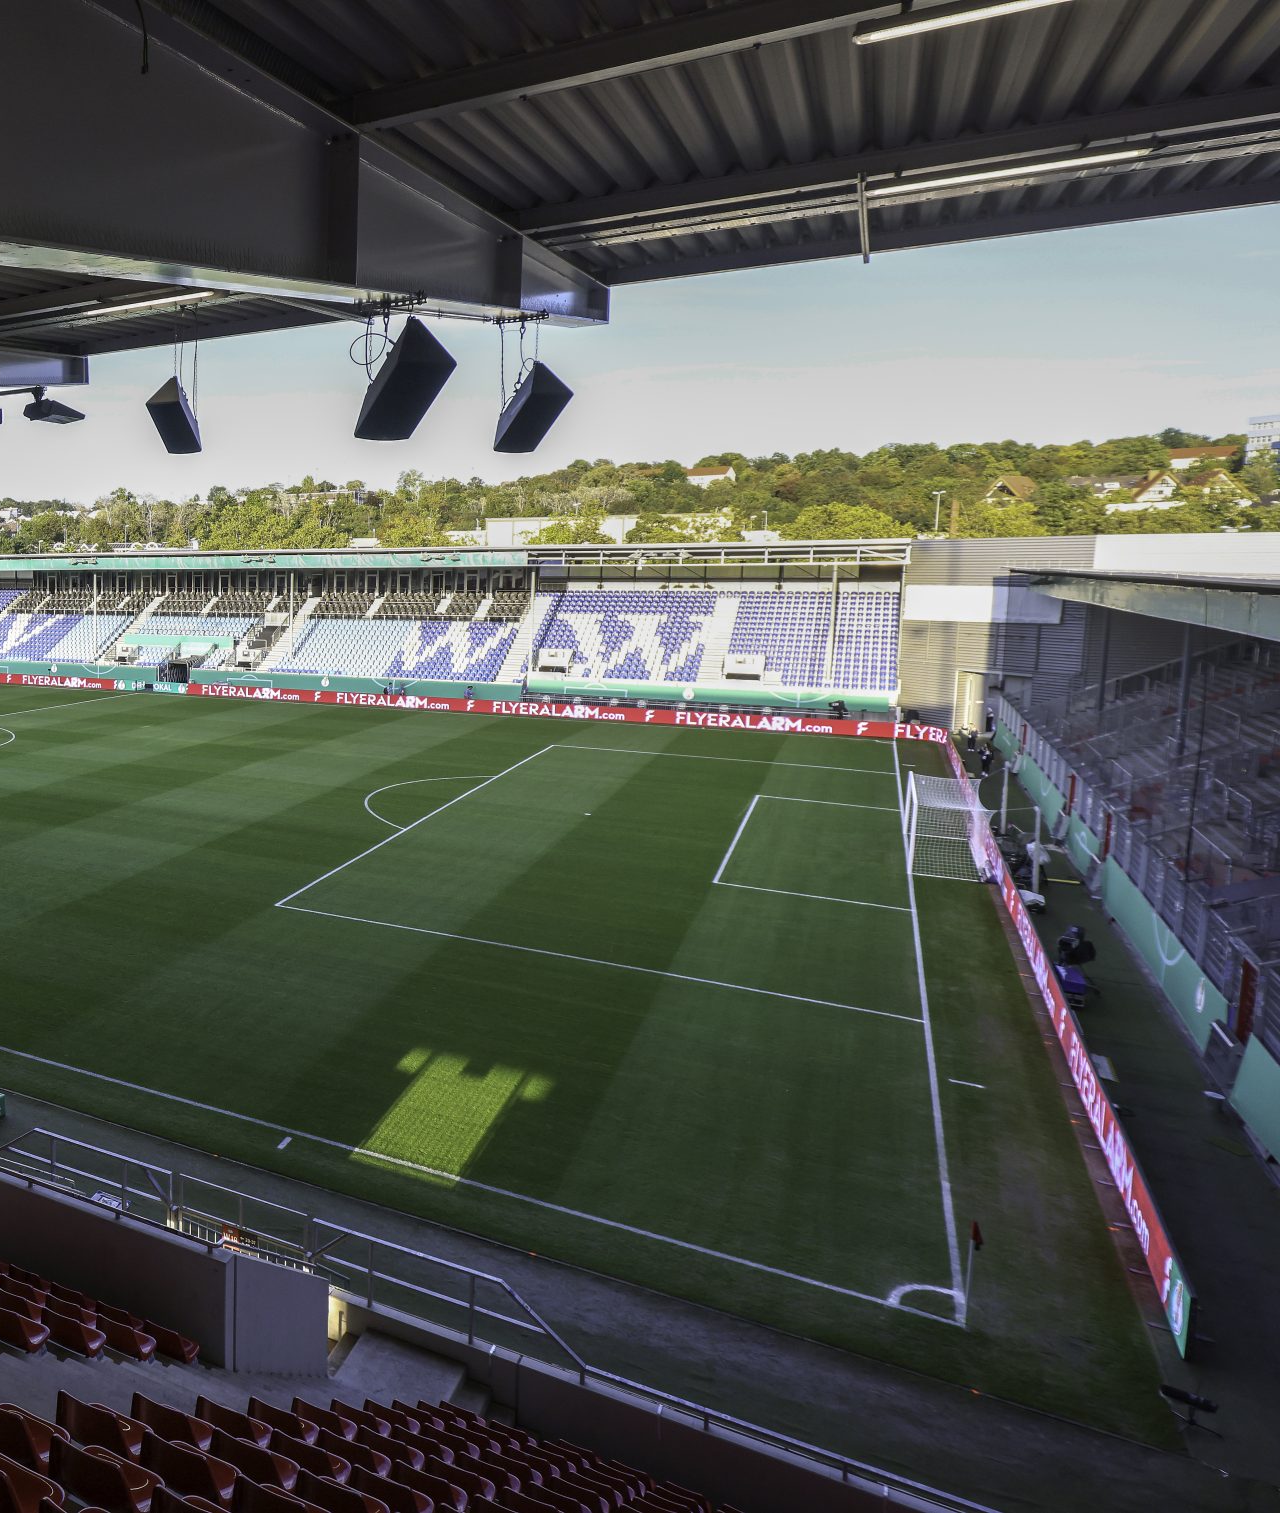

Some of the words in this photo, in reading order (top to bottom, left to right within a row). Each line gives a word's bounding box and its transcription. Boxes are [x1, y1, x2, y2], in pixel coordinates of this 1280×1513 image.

[22, 675, 102, 689] FLYERALARM.com
[202, 684, 300, 701] FLYERALARM.com
[336, 692, 450, 710] FLYERALARM.com
[493, 701, 625, 721] FLYERALARM.com
[675, 711, 833, 734] FLYERALARM.com
[1069, 1031, 1150, 1257] FLYERALARM.com
